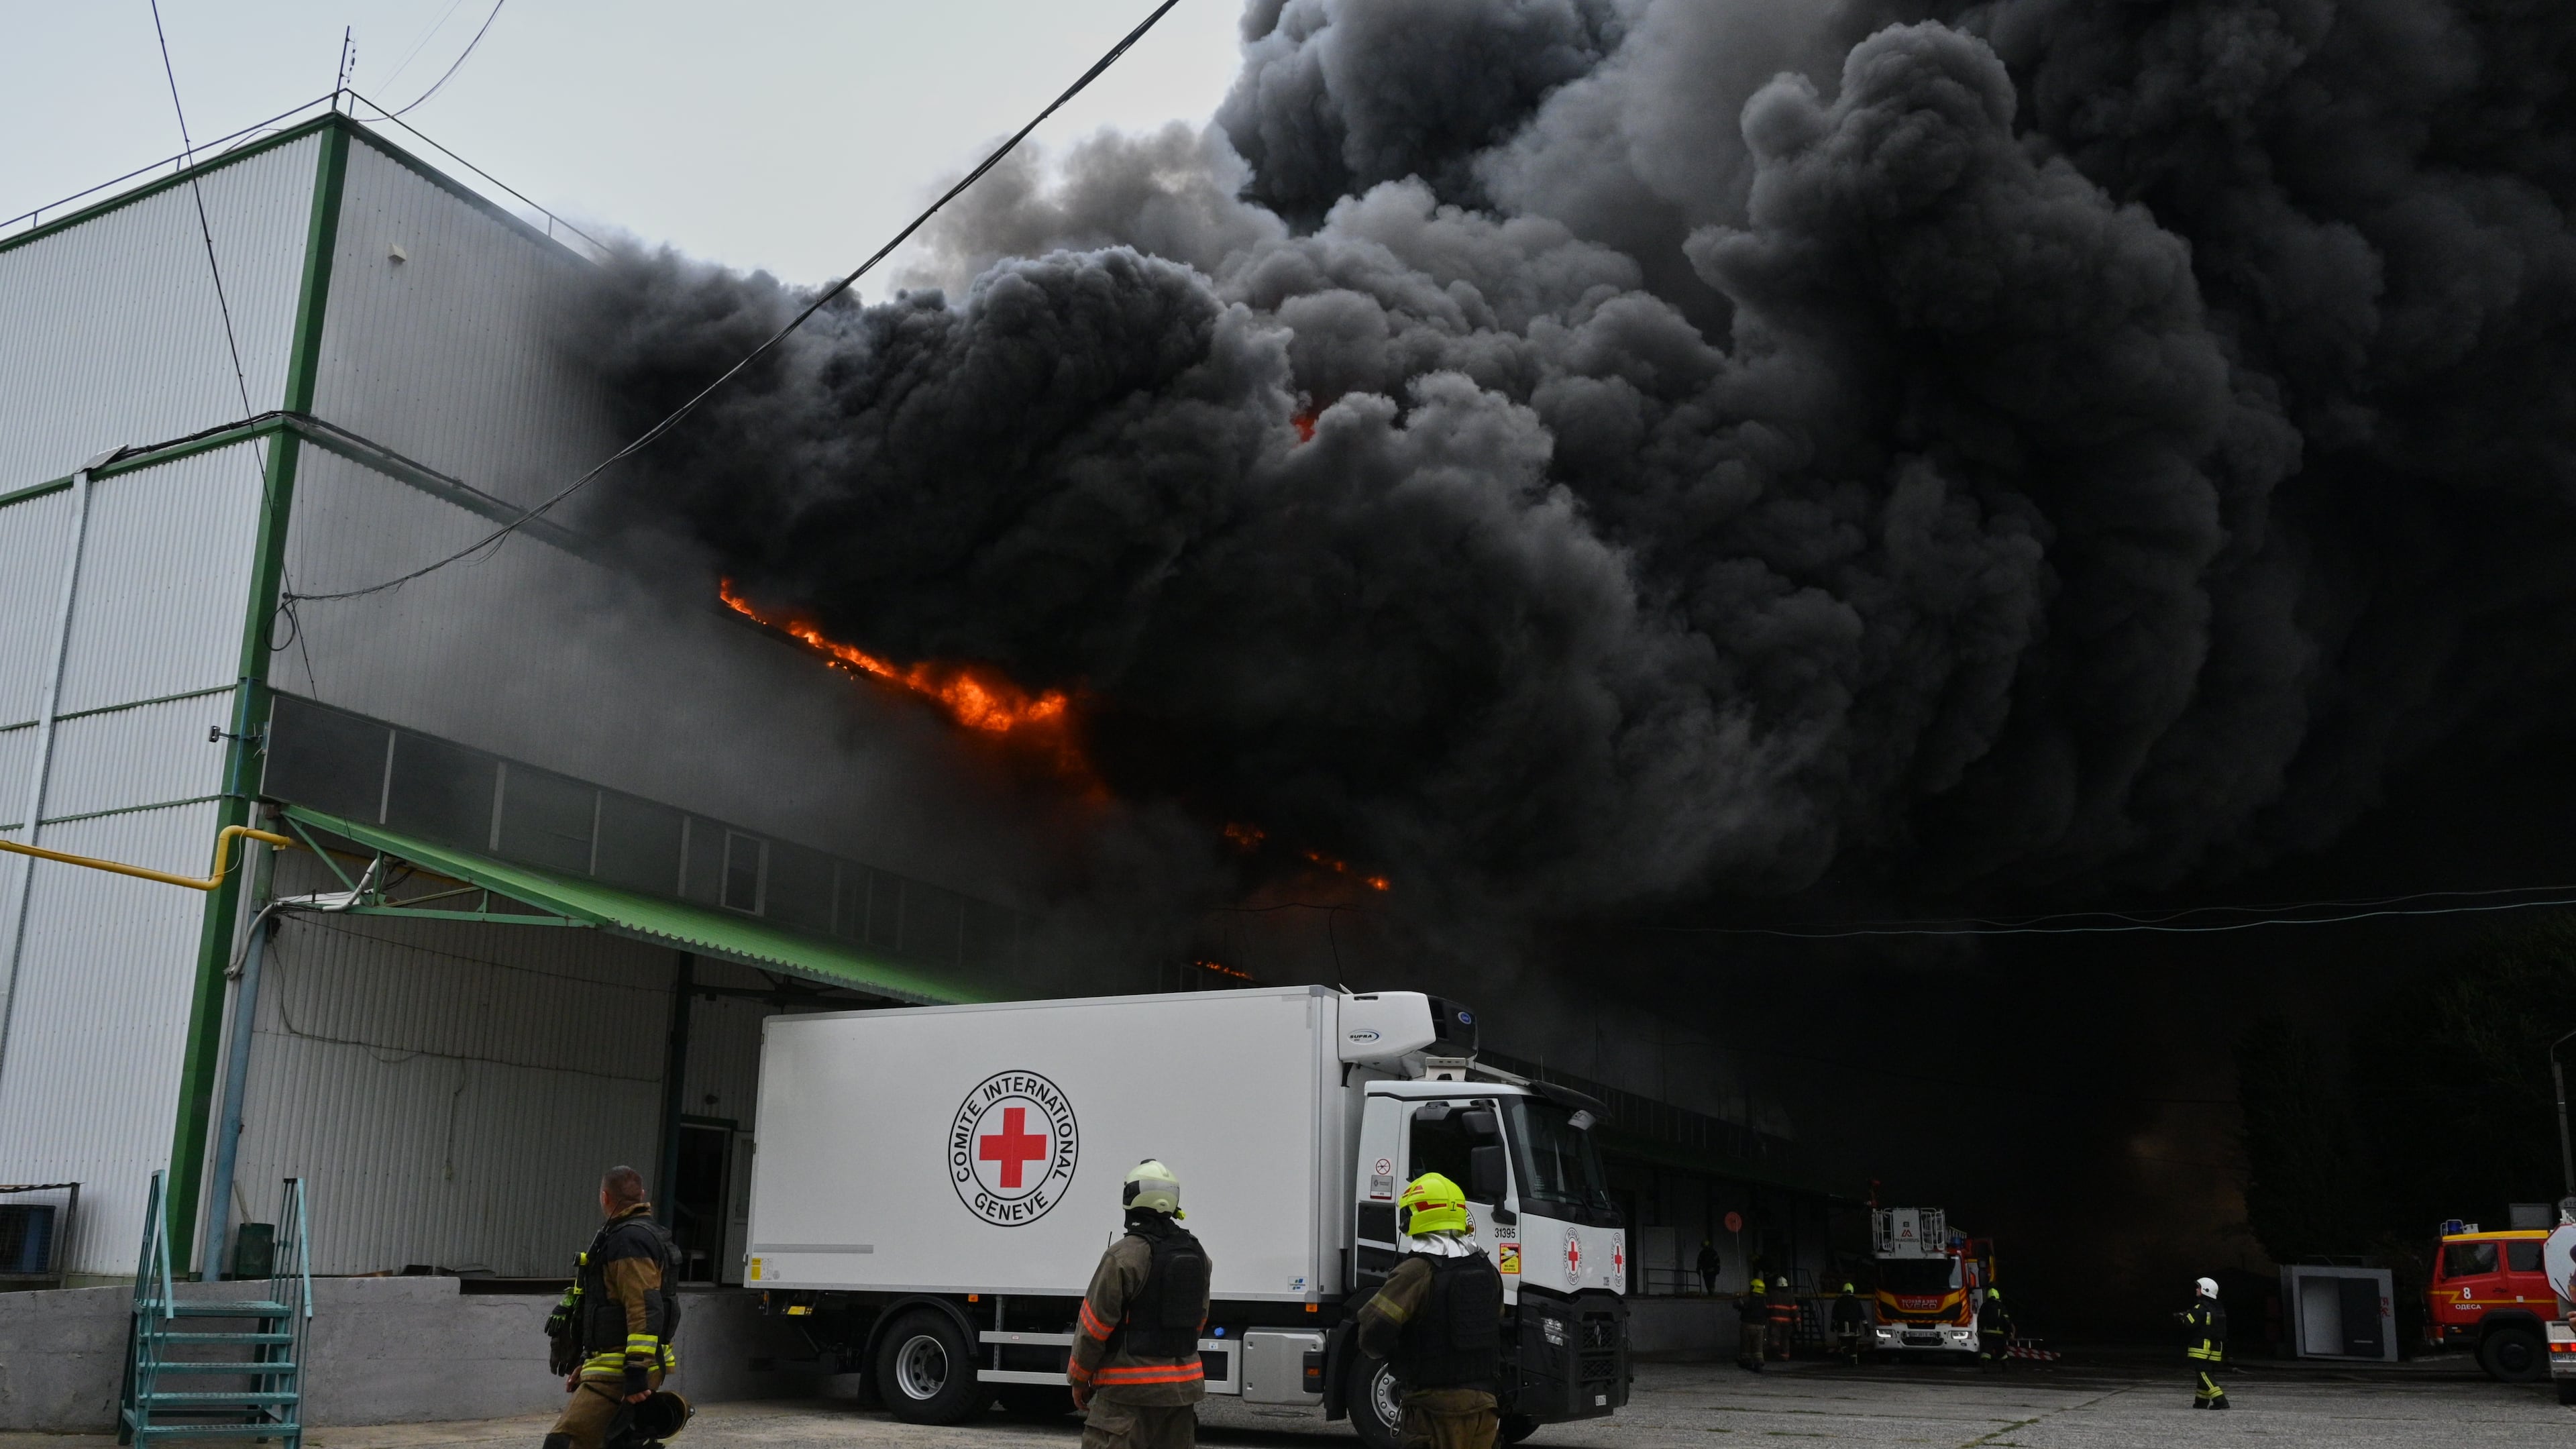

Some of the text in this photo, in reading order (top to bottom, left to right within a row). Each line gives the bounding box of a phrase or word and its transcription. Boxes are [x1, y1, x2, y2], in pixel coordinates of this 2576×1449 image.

[954, 1077, 1073, 1183] COMITE INTERNATIONAL
[975, 1191, 1049, 1220] GENEVE
[1495, 1228, 1515, 1238] 31395
[2463, 1287, 2471, 1299] 8
